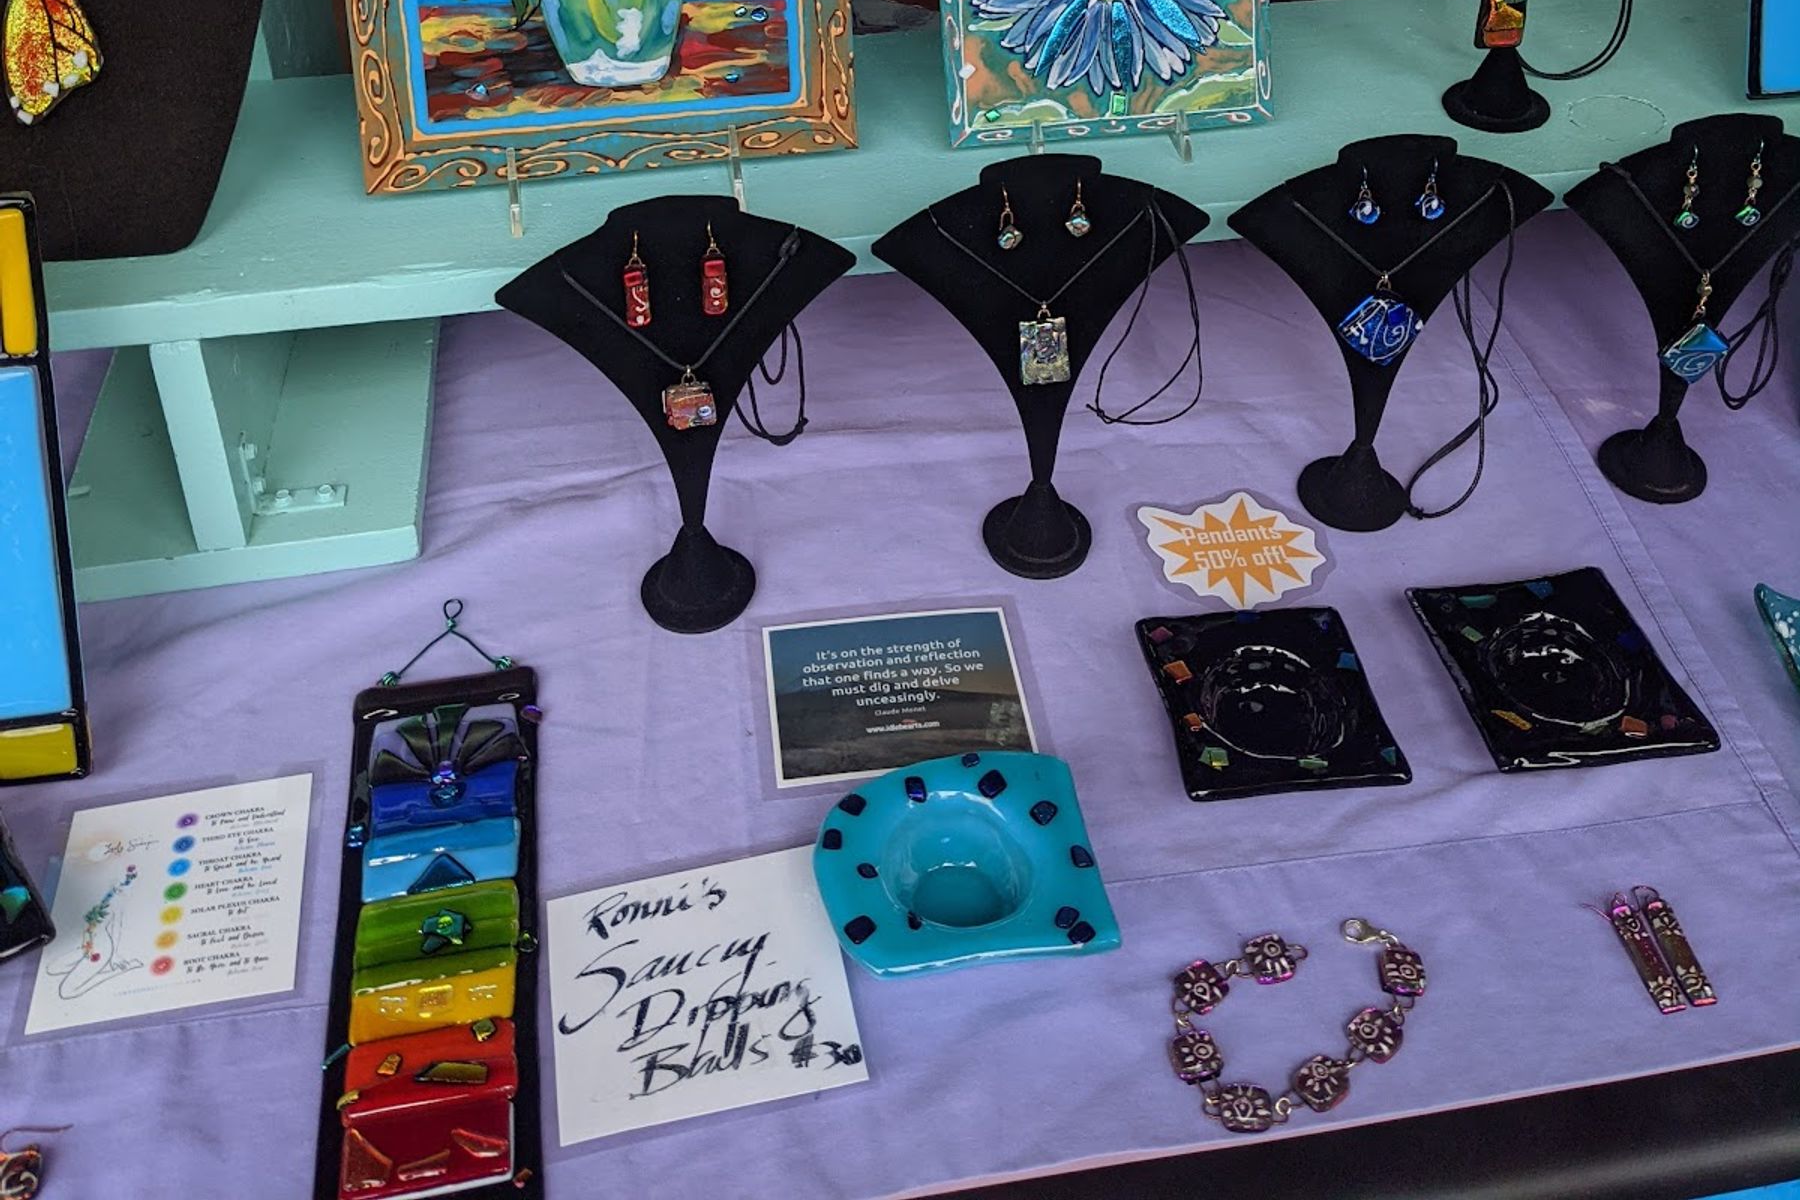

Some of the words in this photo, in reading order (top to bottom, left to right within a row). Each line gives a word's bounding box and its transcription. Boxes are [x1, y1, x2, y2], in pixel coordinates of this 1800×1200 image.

[1181, 525, 1282, 546] Pendants
[1193, 548, 1248, 570] 50%
[1252, 545, 1288, 566] off!
[802, 657, 883, 674] observation
[886, 653, 911, 666] and
[914, 648, 981, 663] reflection
[816, 649, 837, 661] It's
[841, 650, 857, 659] on
[860, 645, 883, 657] the
[886, 639, 944, 655] strength
[947, 638, 962, 648] of
[802, 674, 831, 687] that
[834, 673, 860, 684] one
[863, 668, 897, 682] finds
[900, 669, 908, 678] a
[911, 666, 942, 679] way.
[945, 662, 961, 673] So
[964, 662, 984, 672] we
[831, 684, 866, 697] must
[869, 681, 891, 695] dig
[893, 678, 919, 691] and
[922, 675, 960, 688] delve
[856, 690, 941, 707] unceasingly.
[583, 877, 728, 939] Ronni's
[558, 932, 771, 1035] Saucy
